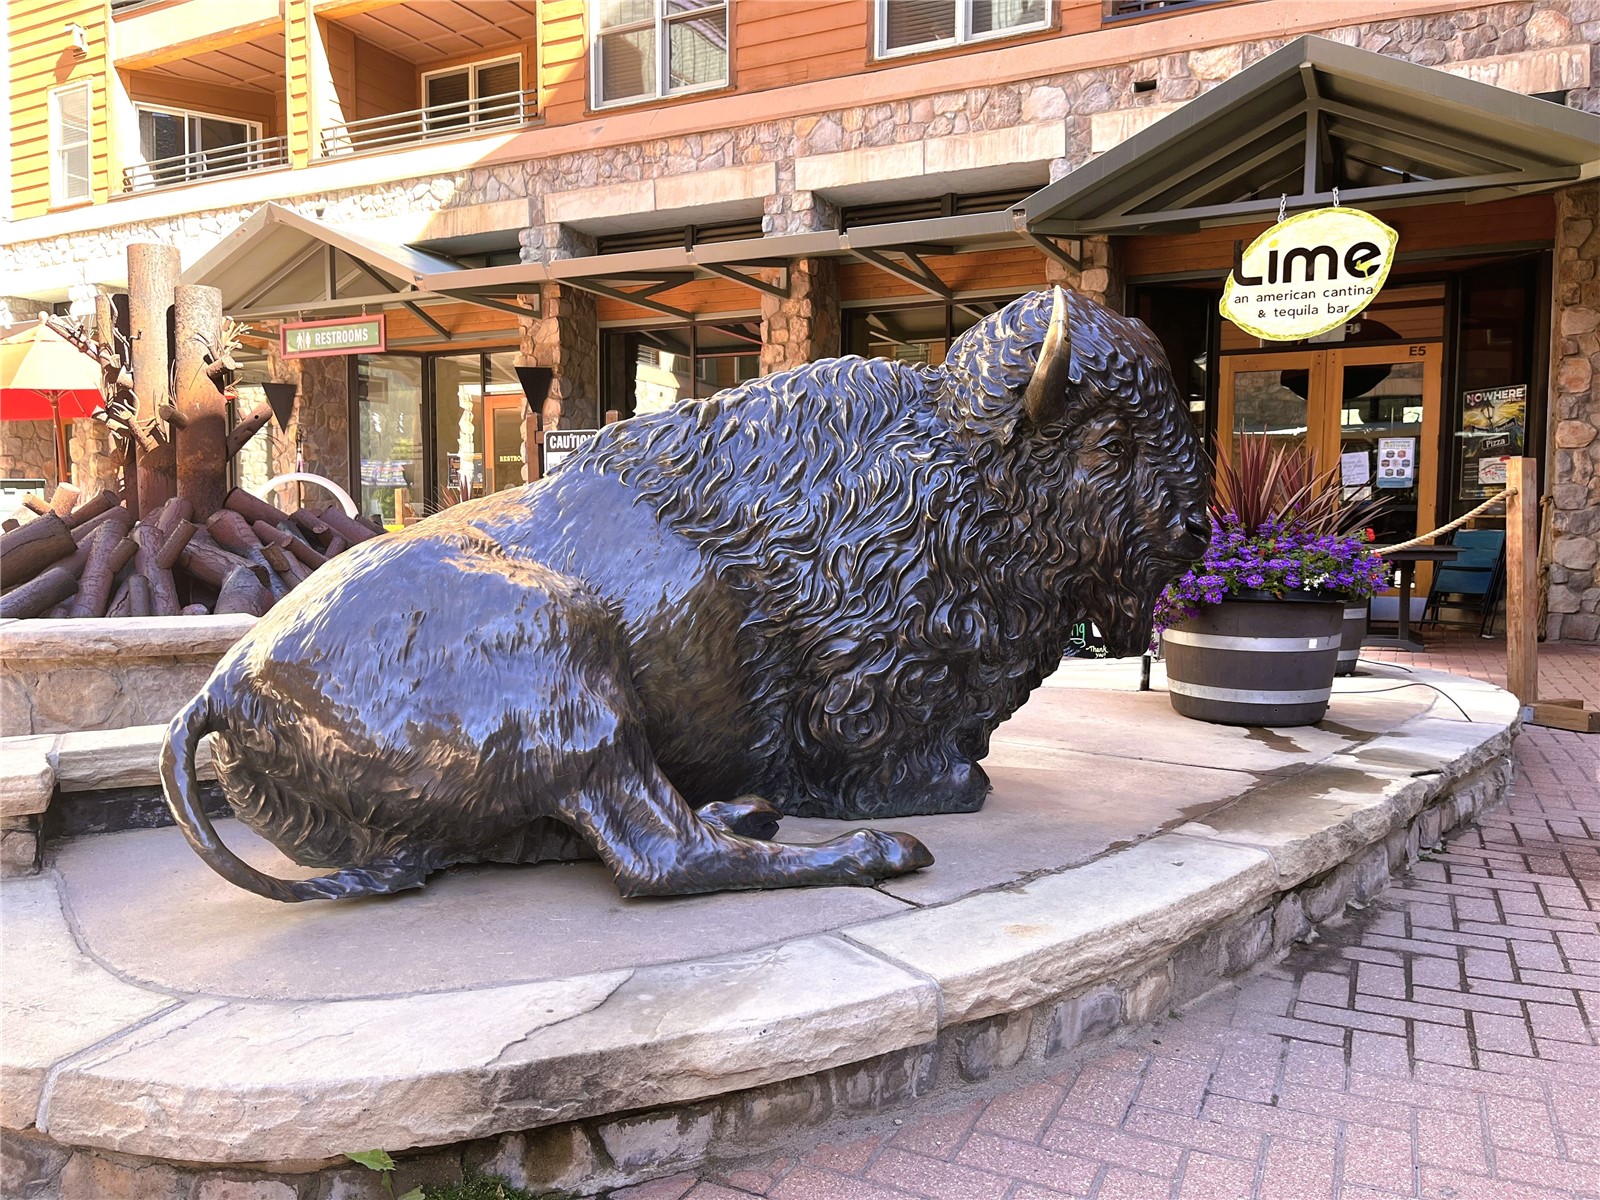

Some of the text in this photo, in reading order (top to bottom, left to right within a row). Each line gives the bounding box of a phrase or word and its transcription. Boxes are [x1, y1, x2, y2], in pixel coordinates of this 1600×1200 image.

[1233, 239, 1381, 286] Lime
[1234, 285, 1373, 304] an american cantina
[1258, 303, 1350, 319] & tequila bar
[315, 328, 368, 345] RESTROOMS
[1409, 346, 1426, 356] E5
[1466, 388, 1524, 406] NOWHERE
[549, 434, 596, 448] CAUTIO
[1485, 438, 1506, 448] Pizza
